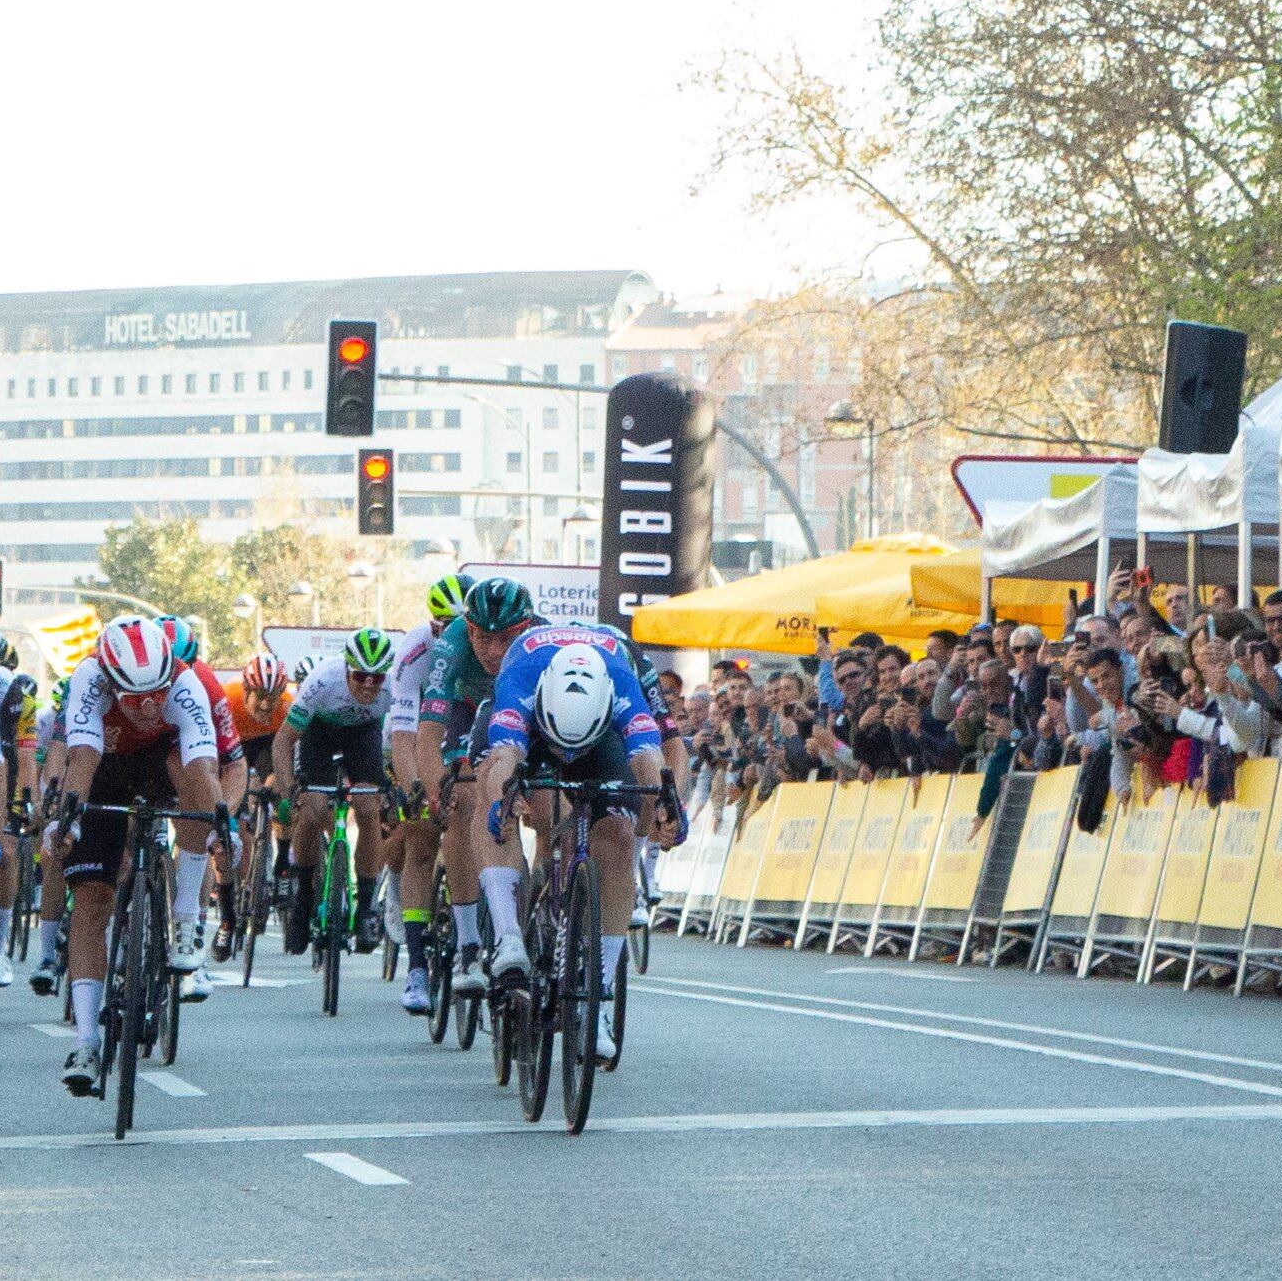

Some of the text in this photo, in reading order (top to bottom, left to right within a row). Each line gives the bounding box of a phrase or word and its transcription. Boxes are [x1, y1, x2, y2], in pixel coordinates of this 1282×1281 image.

[105, 310, 251, 343] HOTEL SABADELL
[173, 688, 212, 738] Cofidis
